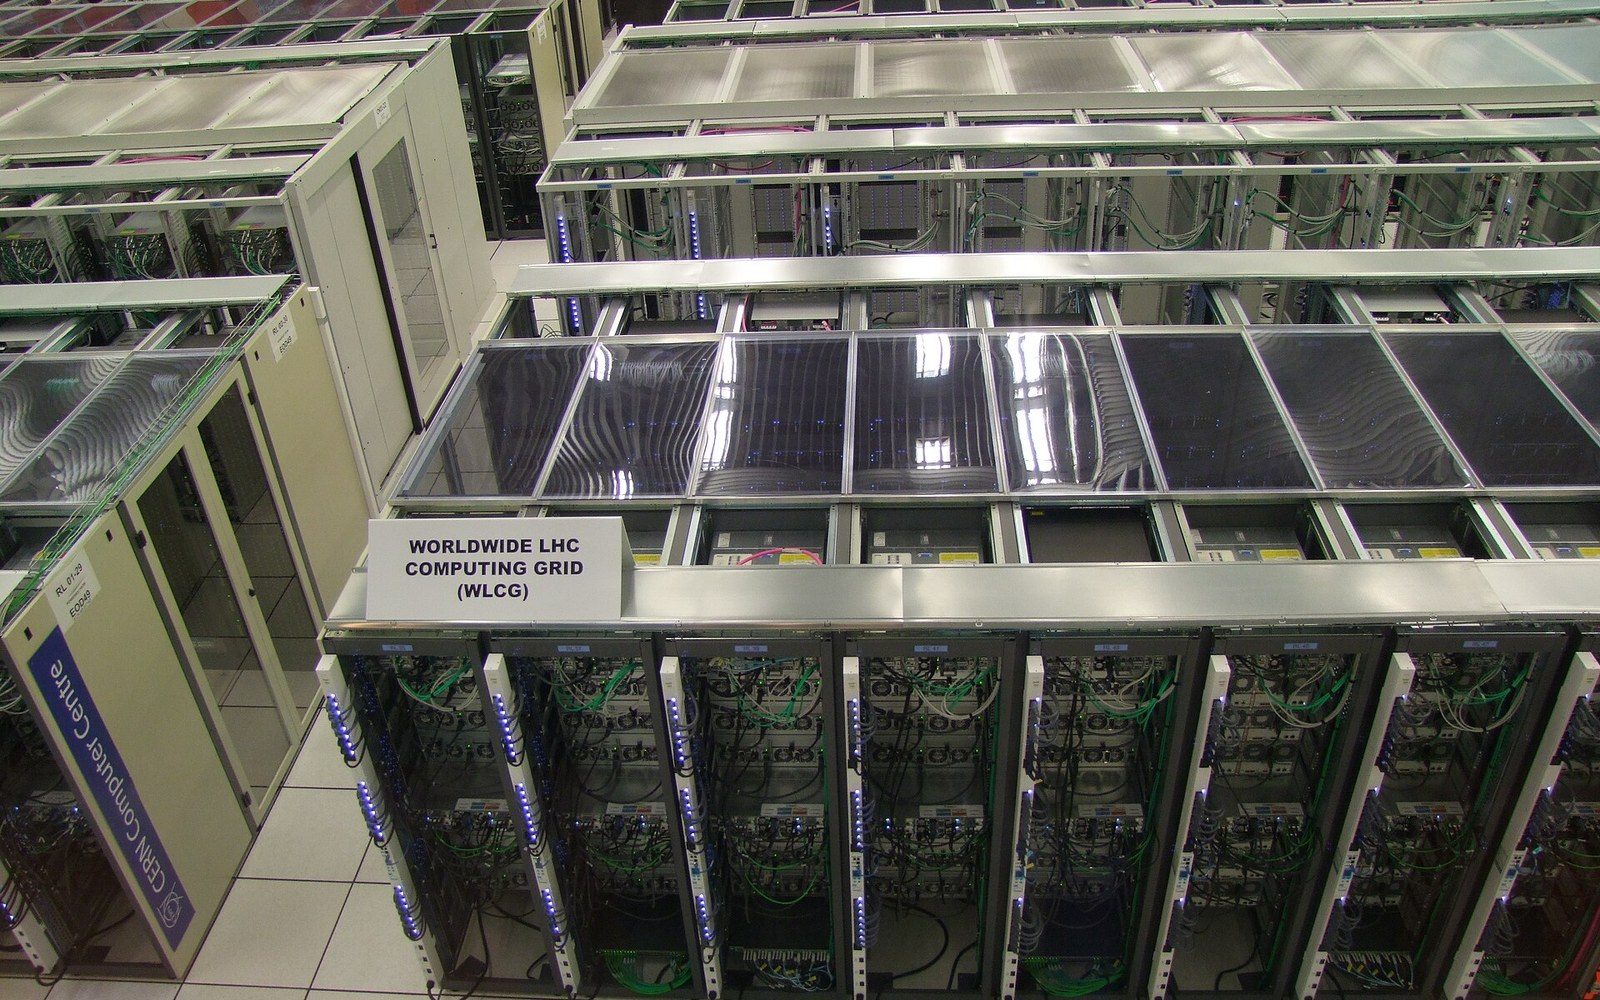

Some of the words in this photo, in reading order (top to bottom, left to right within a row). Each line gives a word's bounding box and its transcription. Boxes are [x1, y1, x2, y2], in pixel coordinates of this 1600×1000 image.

[409, 539, 532, 554] WORLDWIDE
[539, 538, 580, 553] LHC
[55, 584, 68, 597] RL
[66, 563, 83, 585] 01-29
[405, 561, 527, 576] COMPUTING
[533, 560, 583, 575] GRID
[457, 583, 529, 602] (WLCG)
[50, 659, 90, 740] Centre
[86, 737, 140, 841] Computer
[135, 836, 165, 893] CERN
